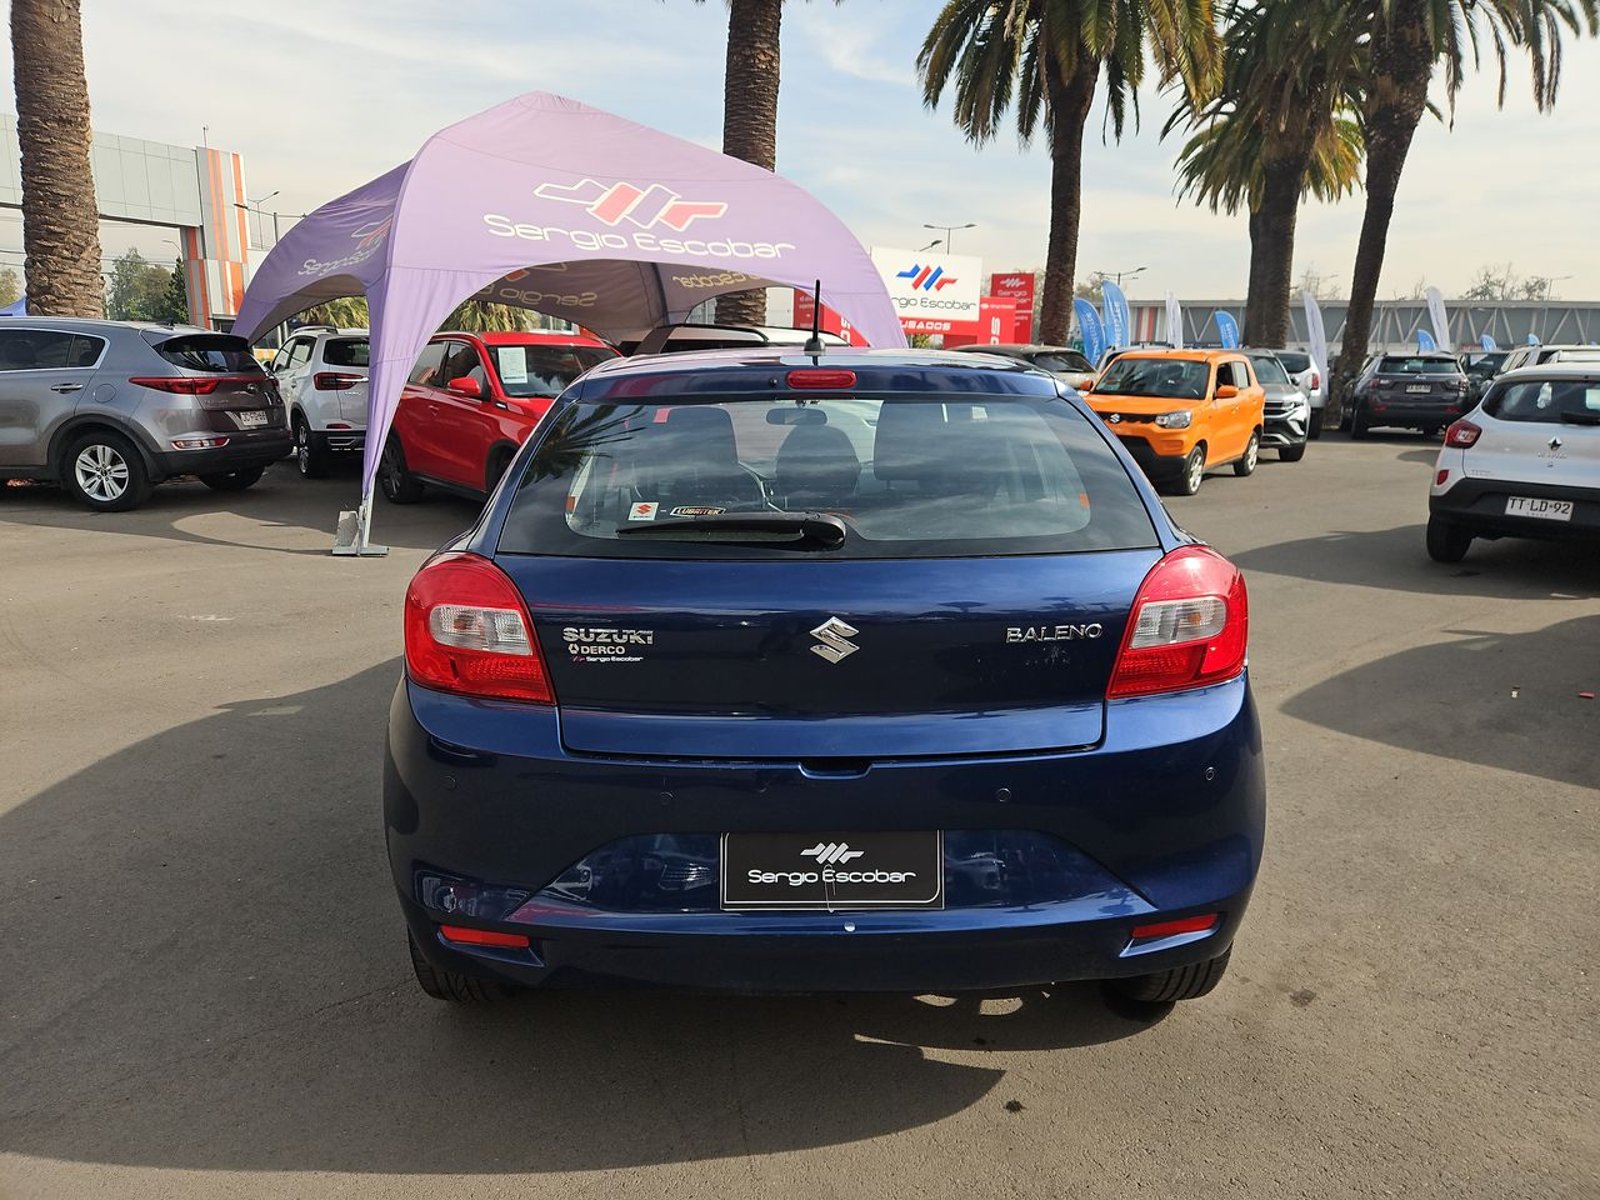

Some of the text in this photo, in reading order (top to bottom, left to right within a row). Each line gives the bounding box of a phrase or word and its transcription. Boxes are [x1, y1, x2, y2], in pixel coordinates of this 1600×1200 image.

[483, 213, 797, 259] Sergio Escobar
[920, 297, 977, 311] Escobar
[563, 627, 654, 645] SUZUKI
[1006, 623, 1103, 644] BALENO
[580, 645, 626, 655] DERCO
[748, 868, 917, 886] Sergio Escobar
